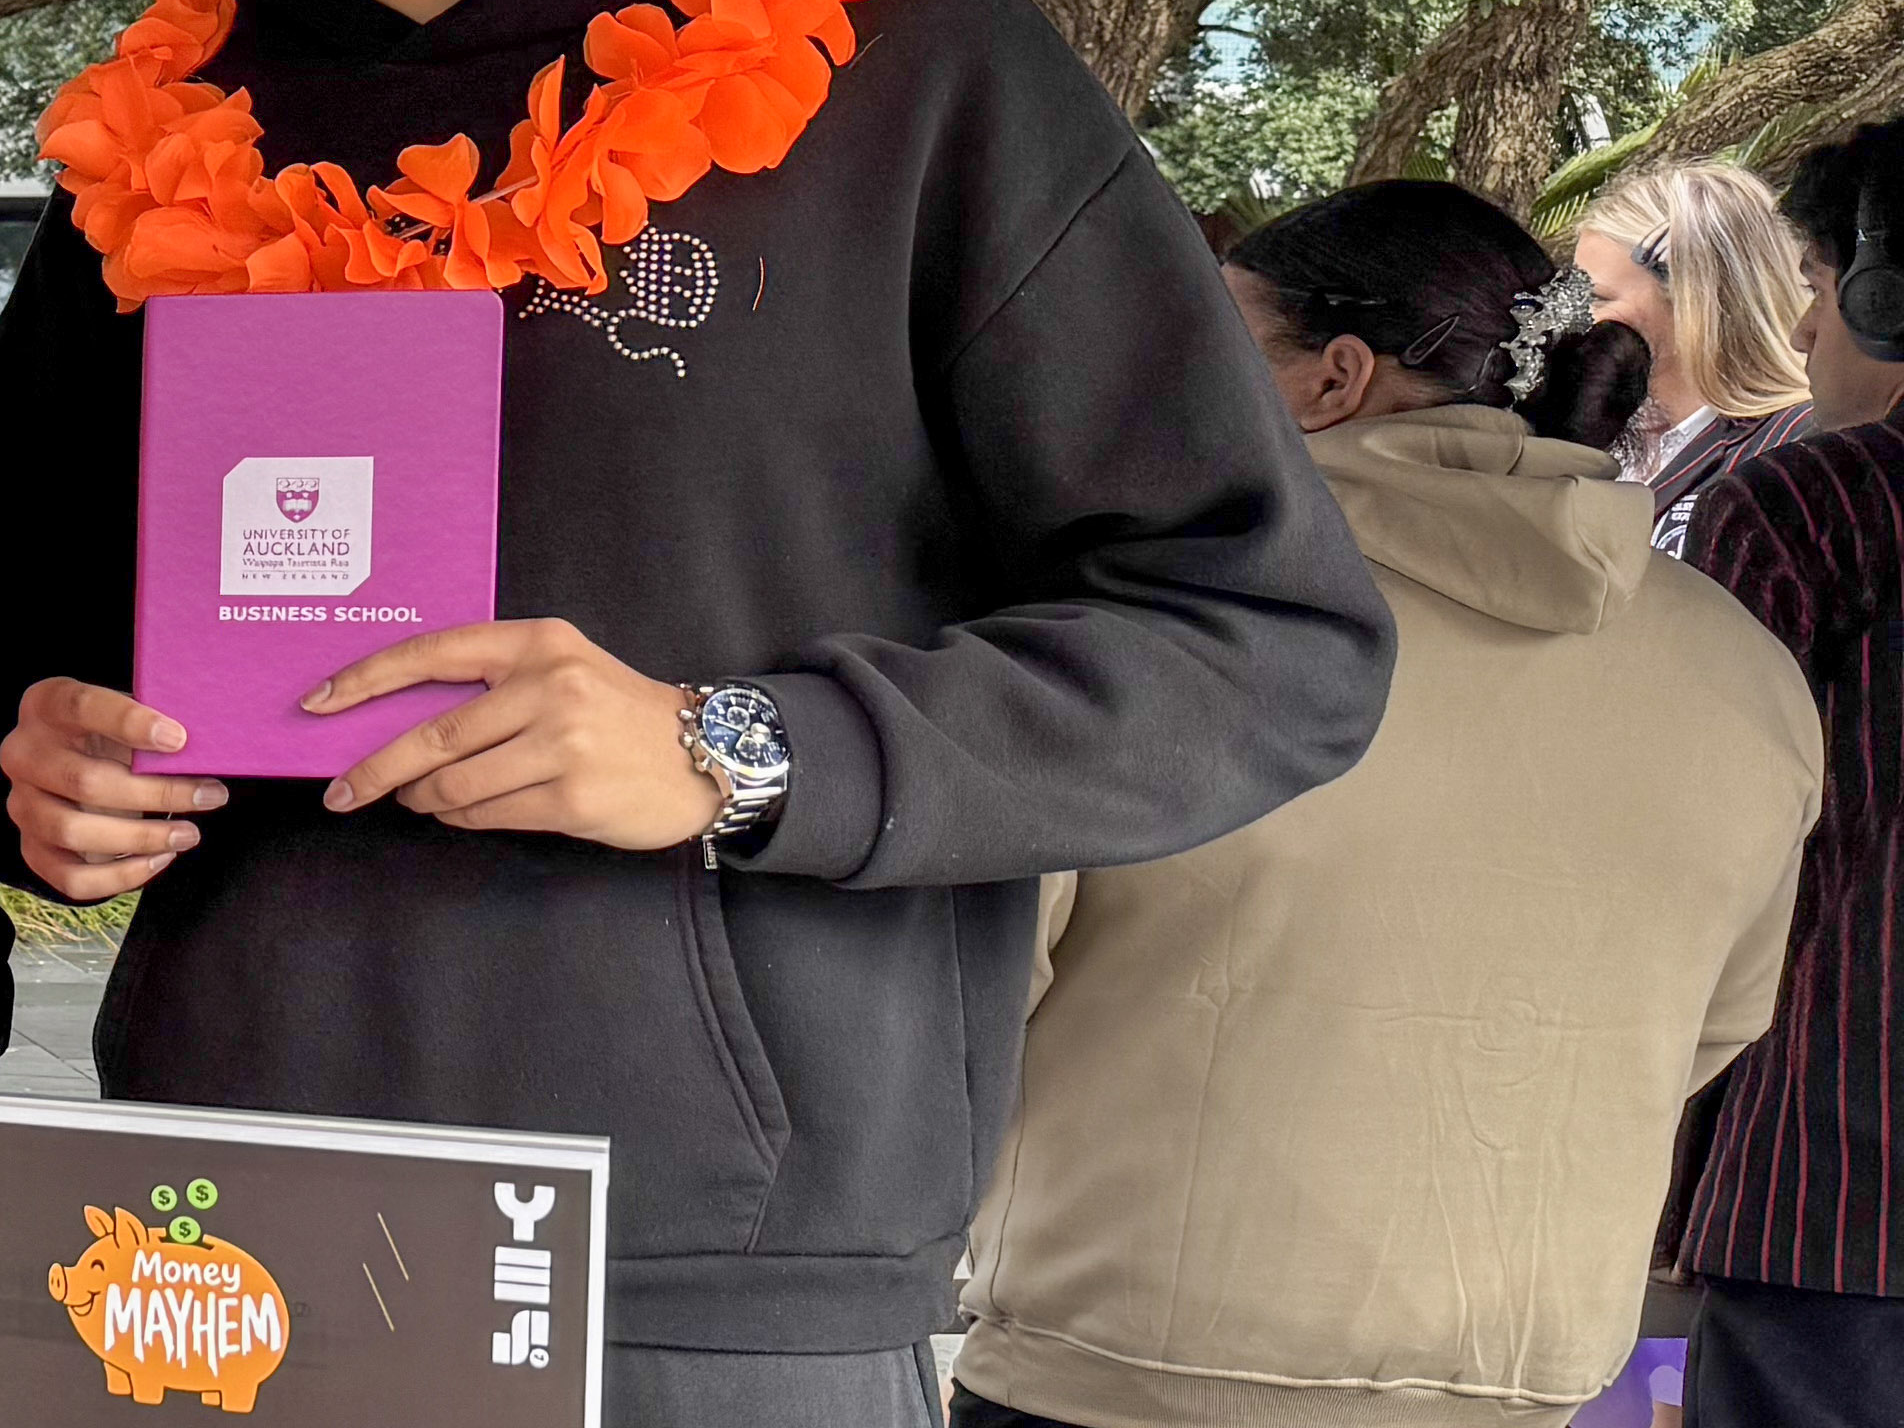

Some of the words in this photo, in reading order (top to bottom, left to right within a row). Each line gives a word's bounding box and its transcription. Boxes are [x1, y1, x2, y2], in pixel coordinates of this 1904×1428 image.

[243, 529, 328, 540] UNIVERSITY
[332, 529, 351, 540] OF
[243, 542, 350, 556] AUCKLAND
[219, 606, 327, 621] BUSINESS
[334, 607, 422, 622] SCHOOL
[132, 1249, 241, 1291] Money
[104, 1288, 282, 1377] MAYHEM
